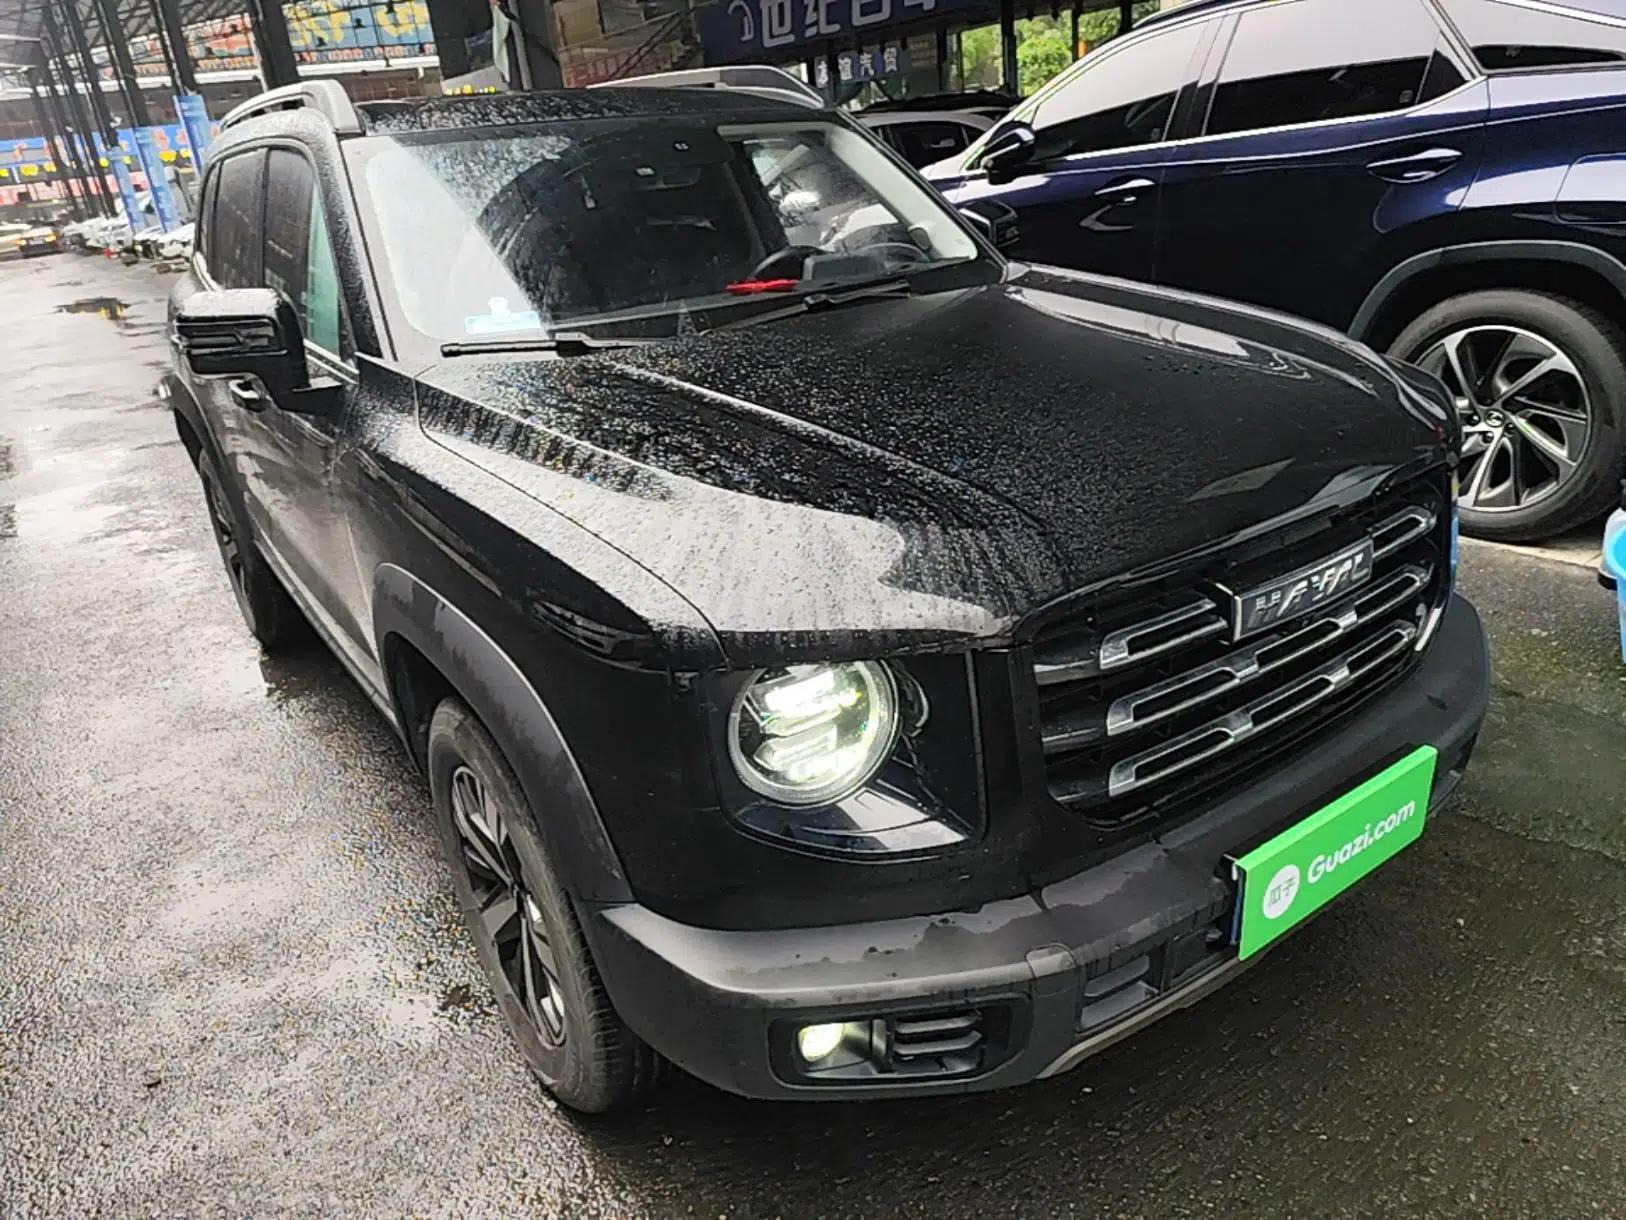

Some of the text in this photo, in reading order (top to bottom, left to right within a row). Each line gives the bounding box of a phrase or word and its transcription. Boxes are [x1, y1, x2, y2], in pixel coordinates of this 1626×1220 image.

[1247, 552, 1370, 628] HAVAL
[1307, 800, 1416, 883] Guazi.com
[1268, 876, 1297, 908] 瓜子
